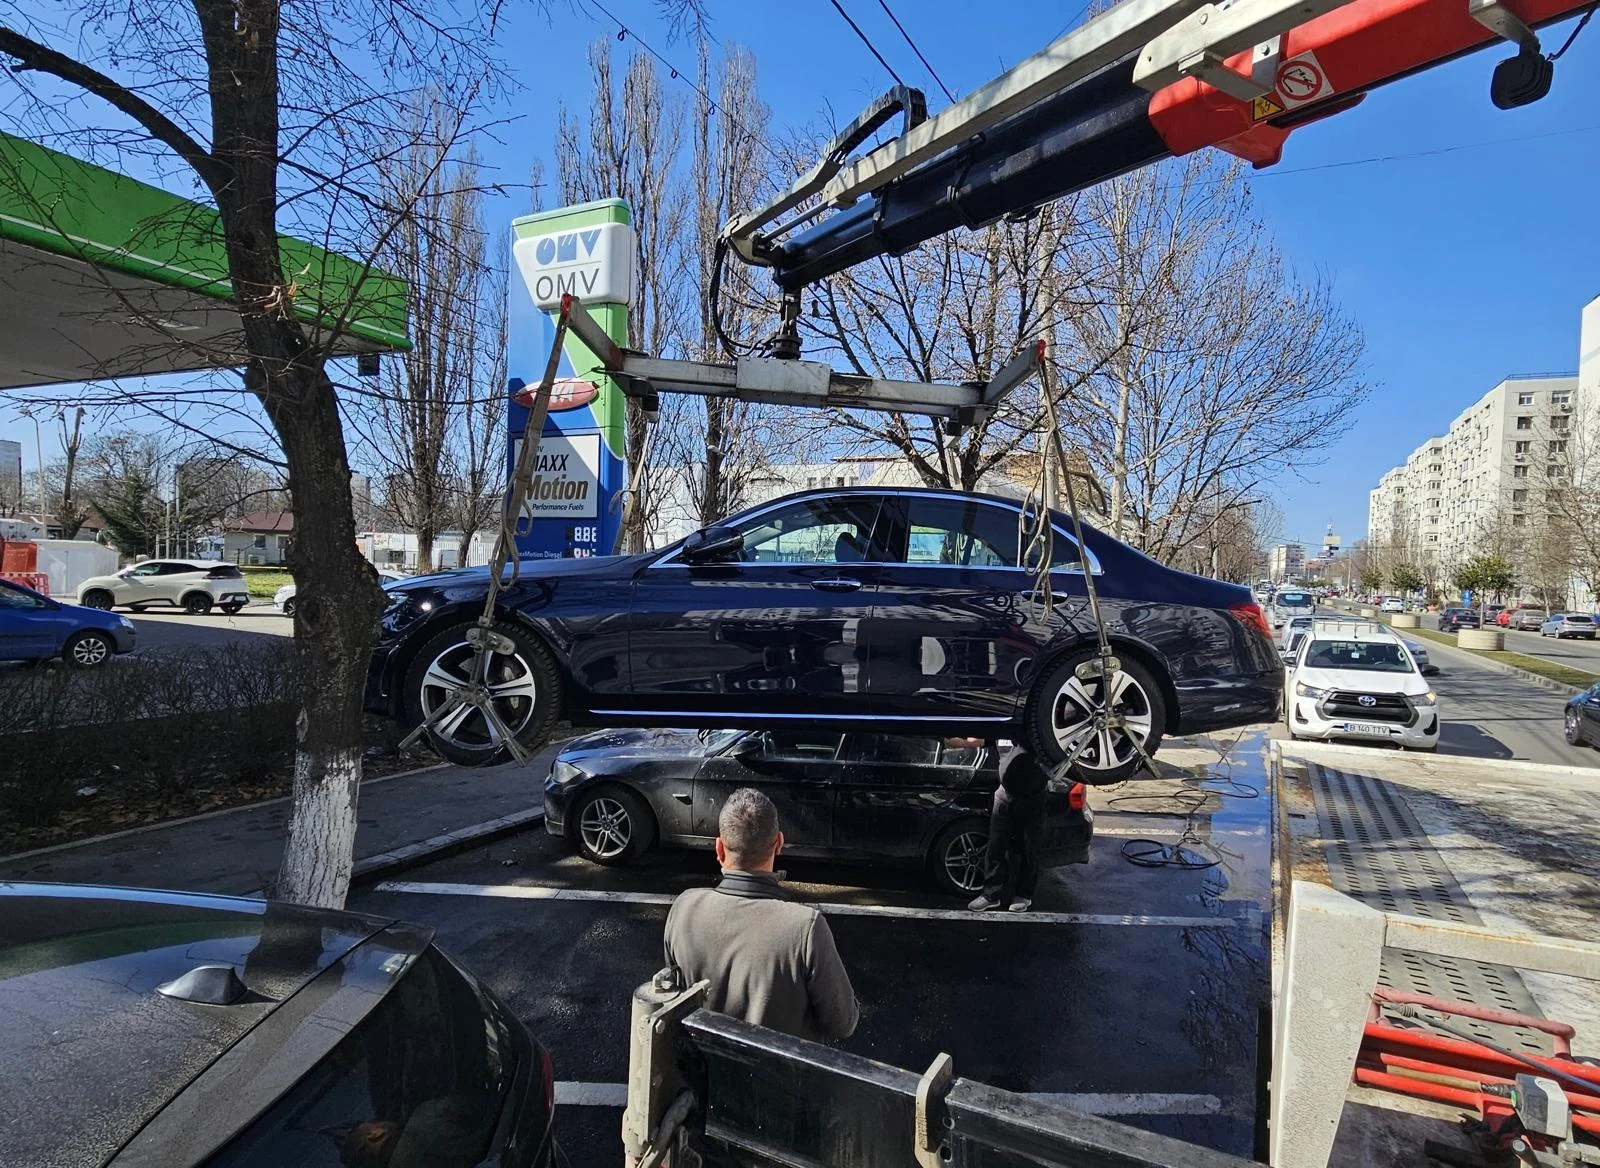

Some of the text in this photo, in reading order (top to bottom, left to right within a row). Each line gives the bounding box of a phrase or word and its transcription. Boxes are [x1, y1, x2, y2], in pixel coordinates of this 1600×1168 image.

[536, 228, 603, 266] OMV
[536, 268, 600, 301] OMV
[527, 473, 589, 501] Motion
[531, 502, 584, 512] Performance Fuels
[544, 550, 562, 559] Diesel
[1358, 725, 1370, 733] 140
[1373, 726, 1387, 734] TTV
